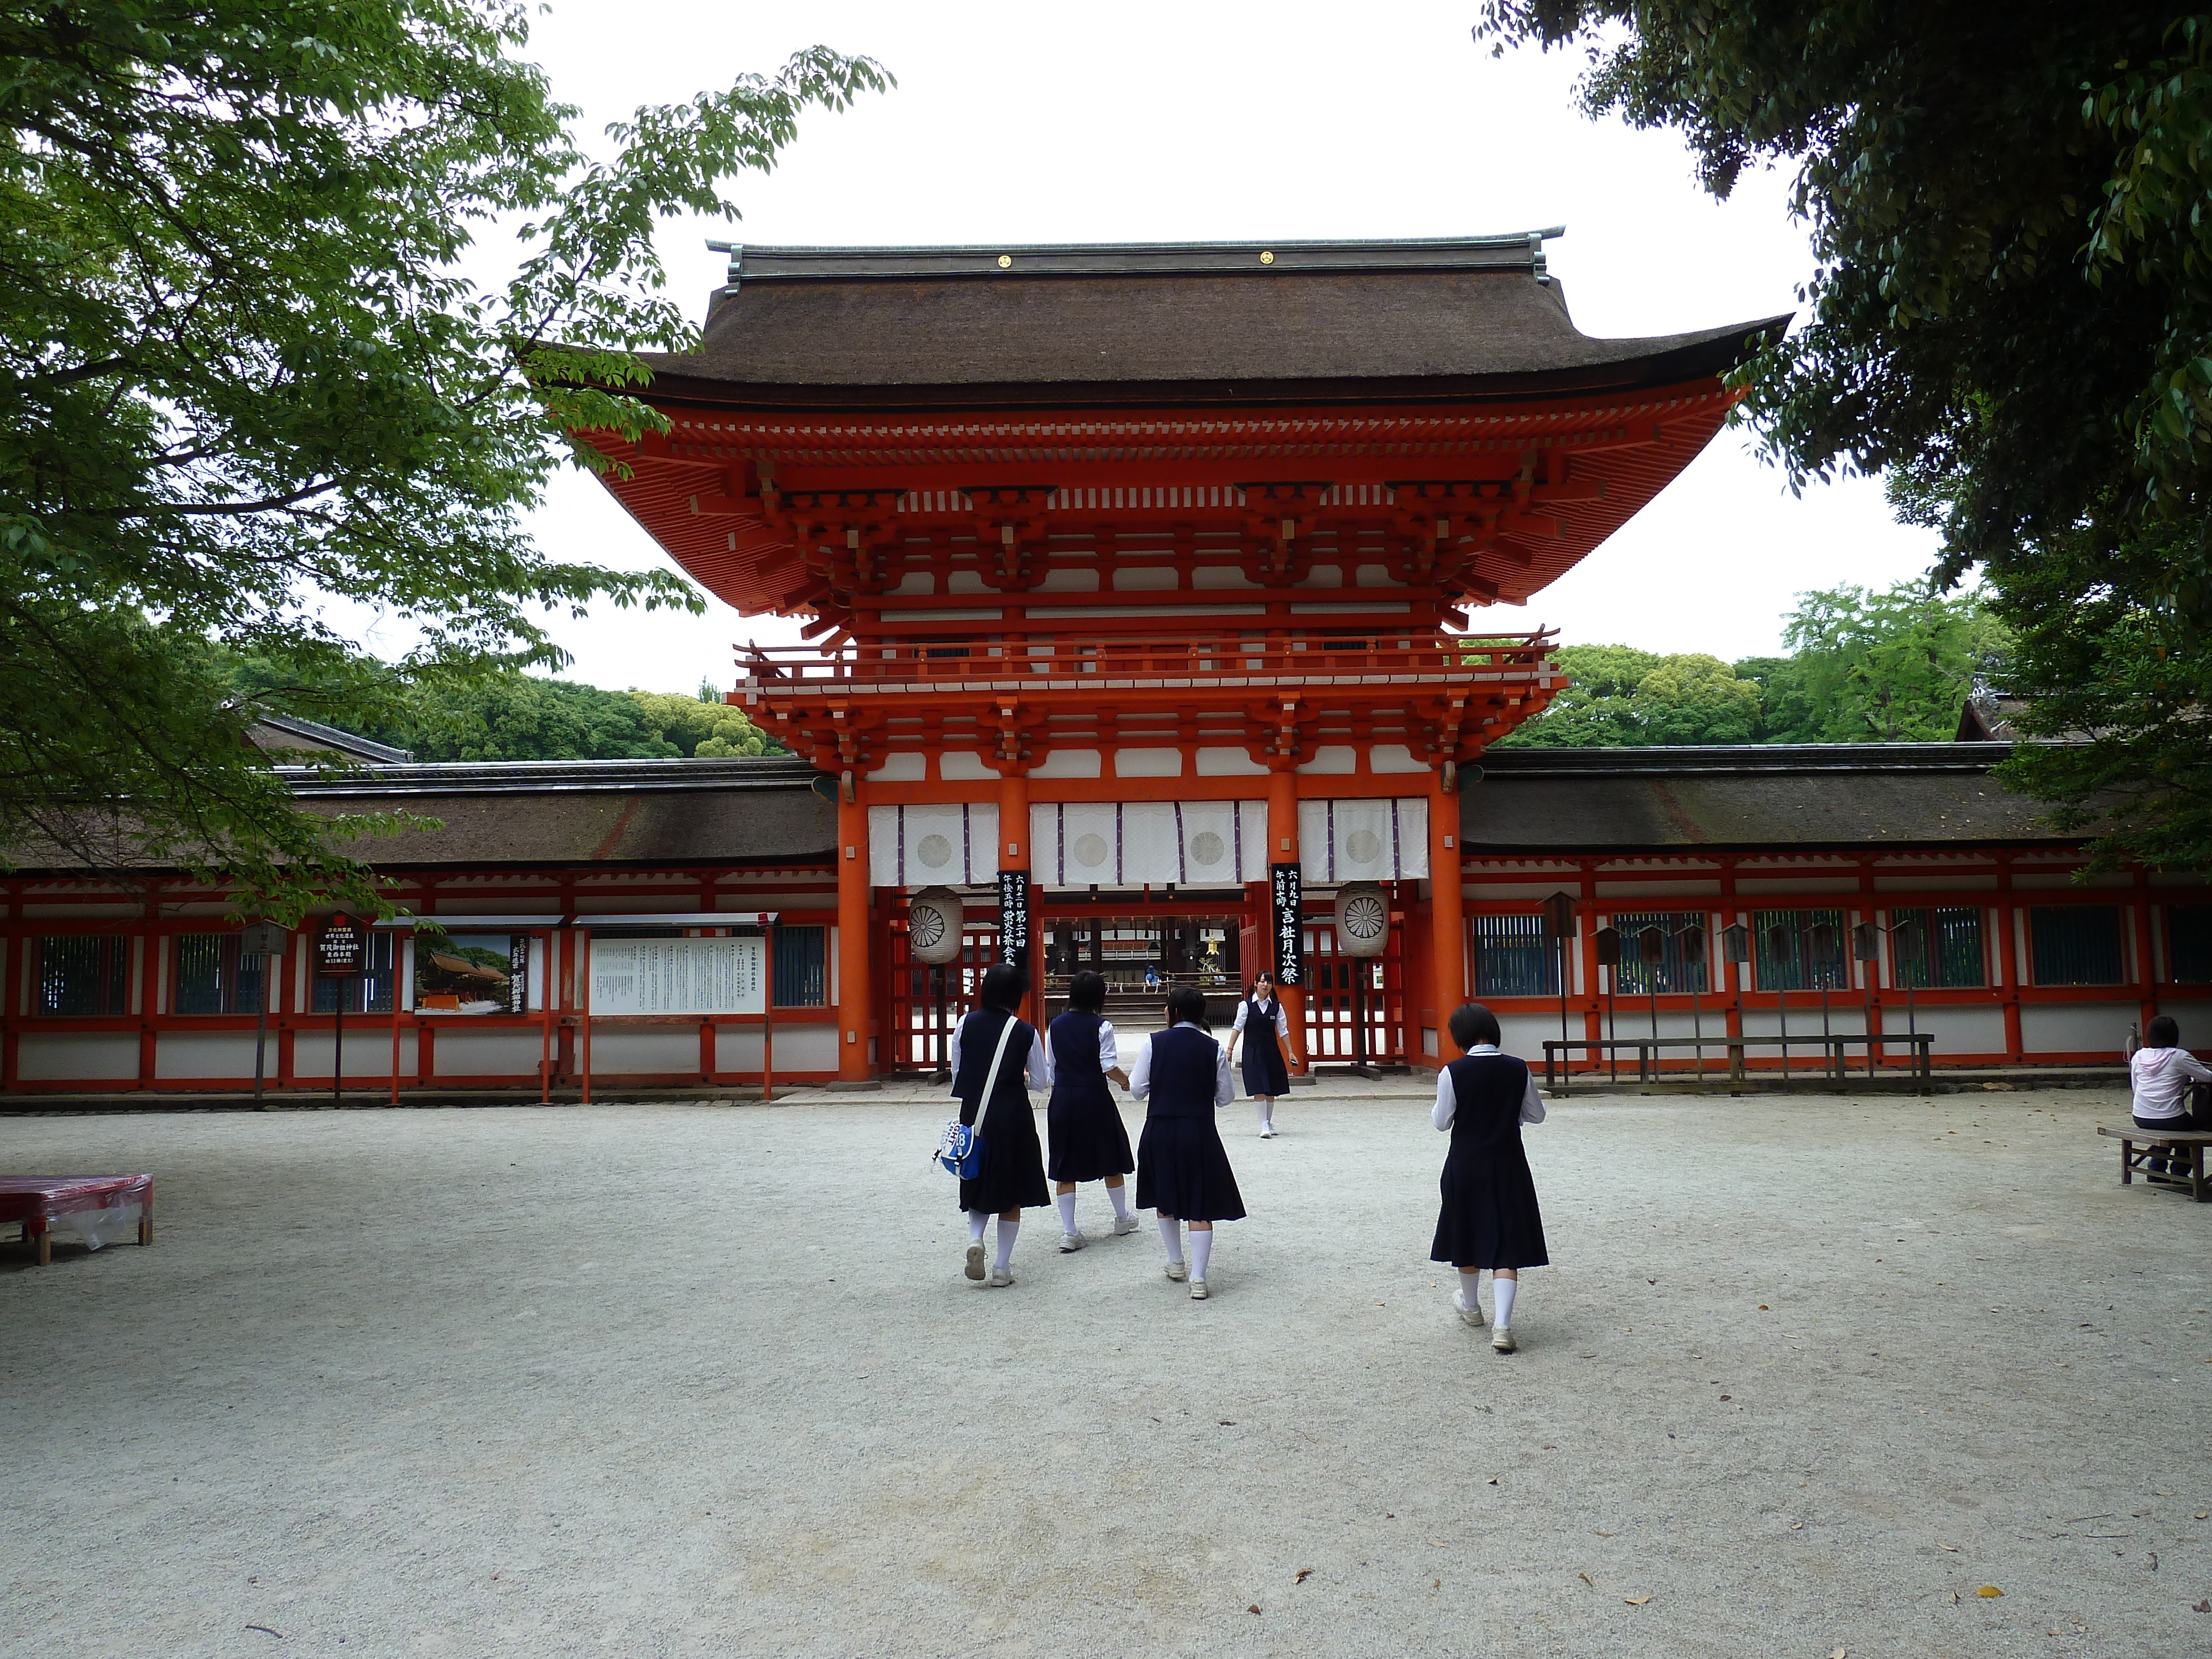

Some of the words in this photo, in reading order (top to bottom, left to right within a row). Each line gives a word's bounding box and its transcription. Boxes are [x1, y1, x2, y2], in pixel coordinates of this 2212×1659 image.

[1003, 874, 1014, 909] 午後五時
[1015, 875, 1025, 908] 六月十二日
[1276, 870, 1287, 907] 午前十時
[1288, 870, 1299, 907] 六月九日
[1015, 910, 1026, 948] 第二十回
[1279, 907, 1299, 984] 言社月次祭
